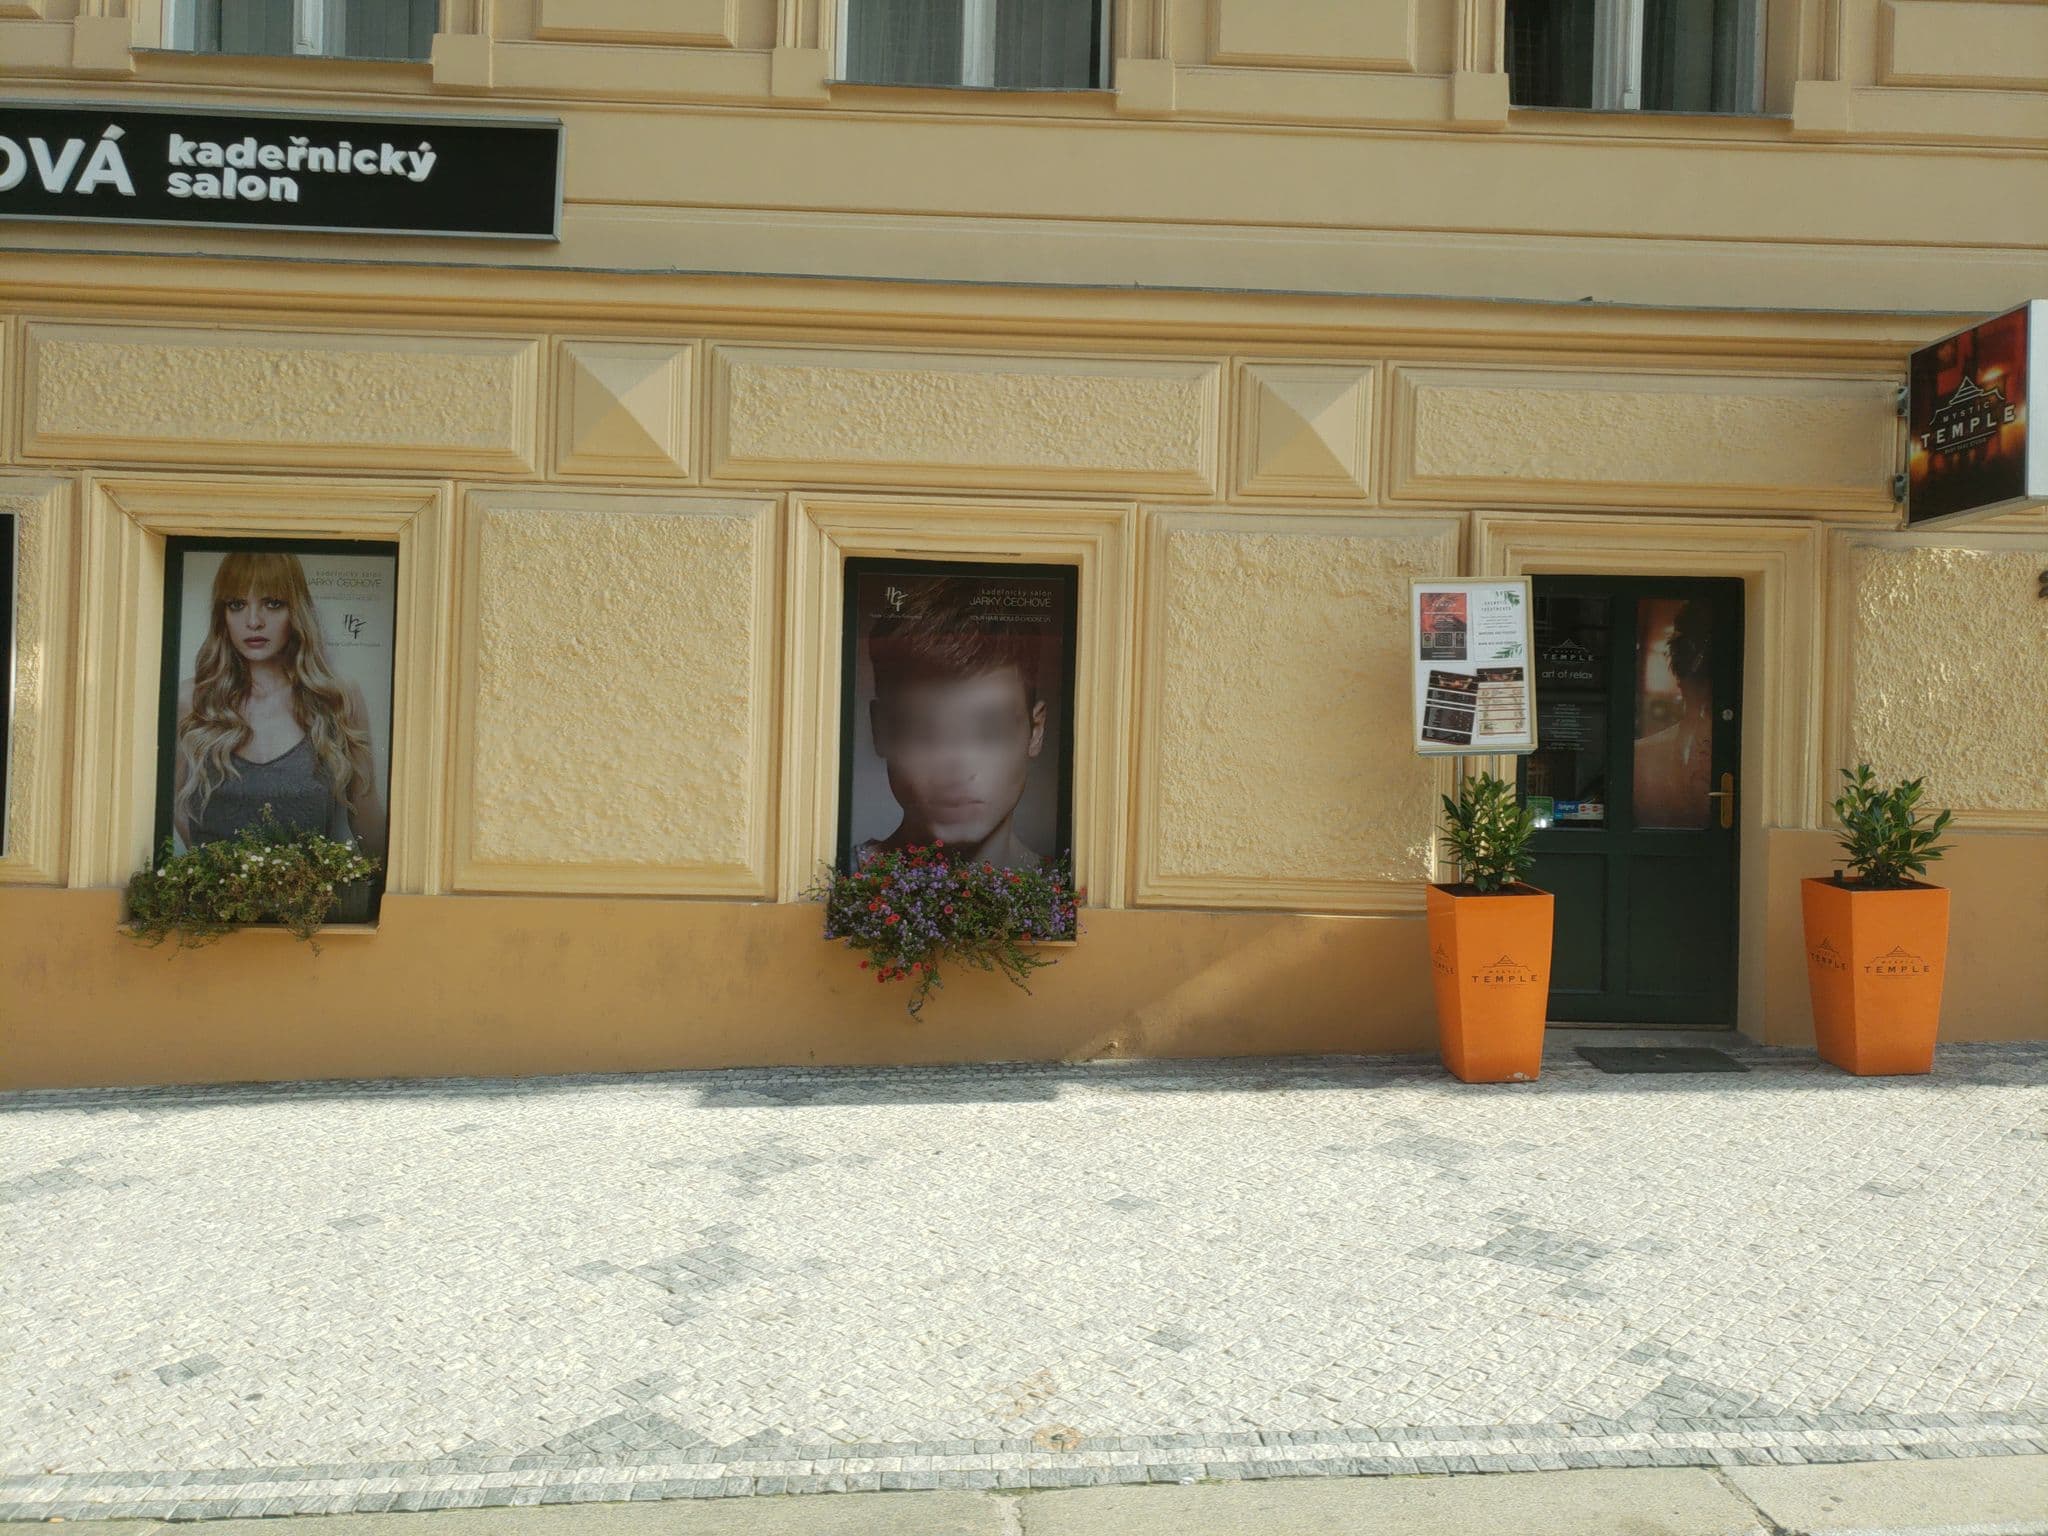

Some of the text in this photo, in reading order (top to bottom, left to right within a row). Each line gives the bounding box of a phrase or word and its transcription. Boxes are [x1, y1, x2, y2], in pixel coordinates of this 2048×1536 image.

[167, 133, 438, 182] kadeřnický
[167, 167, 299, 203] salon
[1943, 402, 1989, 422] MYSTIC
[1921, 405, 2015, 448] TEMPLE
[968, 595, 1002, 606] JARKY
[1542, 654, 1594, 662] TEMPLE
[1557, 669, 1568, 679] of
[1864, 965, 1930, 973] TEMPLE
[1472, 975, 1537, 983] TEMPLE
